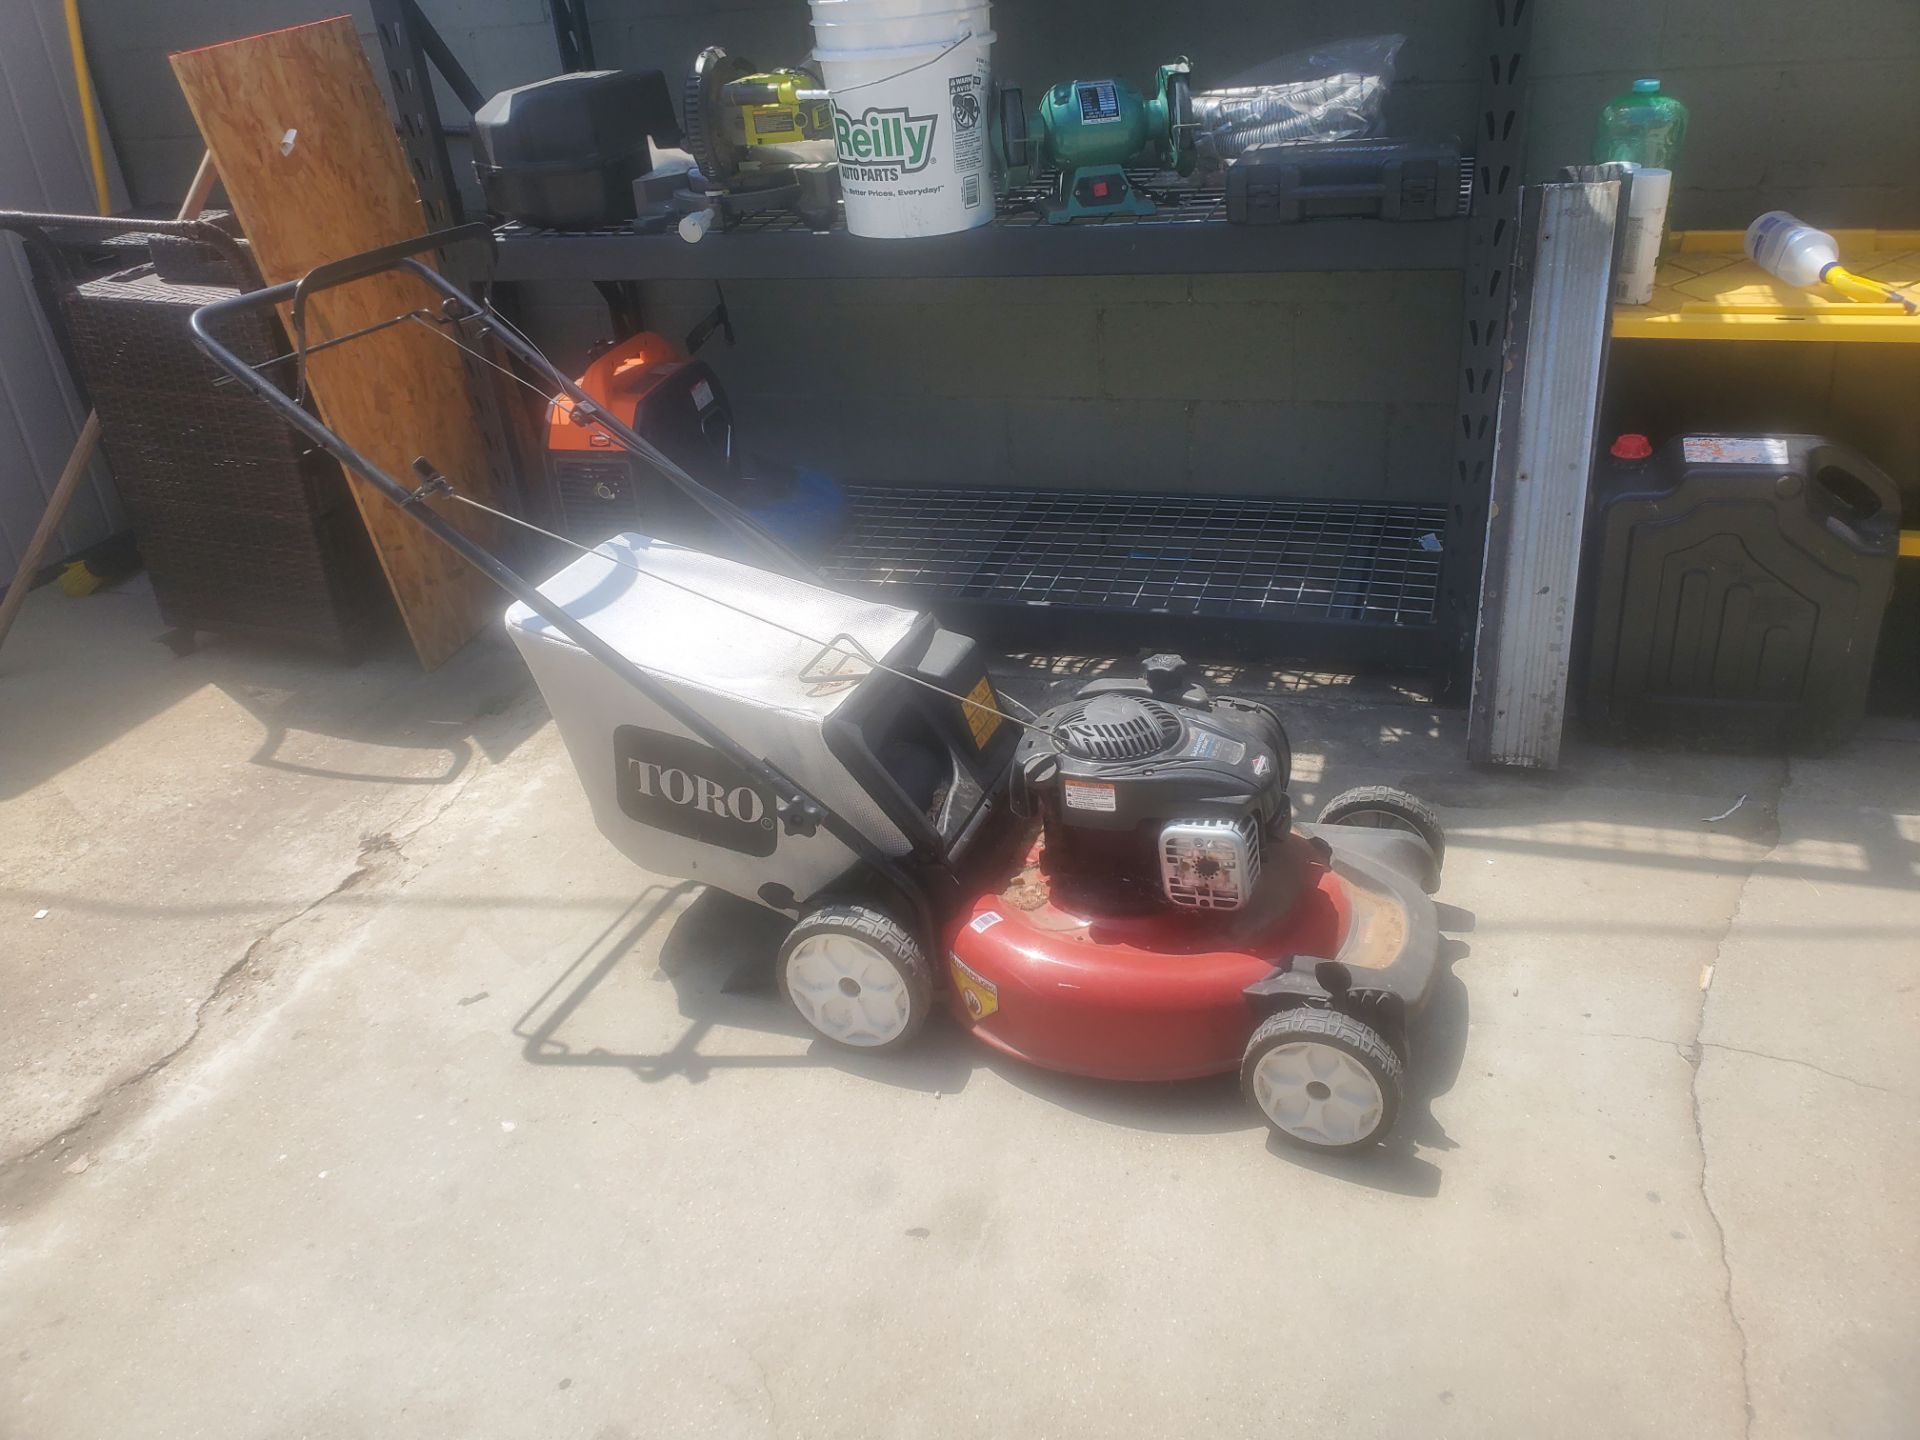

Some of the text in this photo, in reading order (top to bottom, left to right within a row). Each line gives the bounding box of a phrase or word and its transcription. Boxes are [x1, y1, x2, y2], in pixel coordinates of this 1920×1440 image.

[842, 166, 899, 182] AUTO PARTS
[628, 758, 765, 823] TORO
